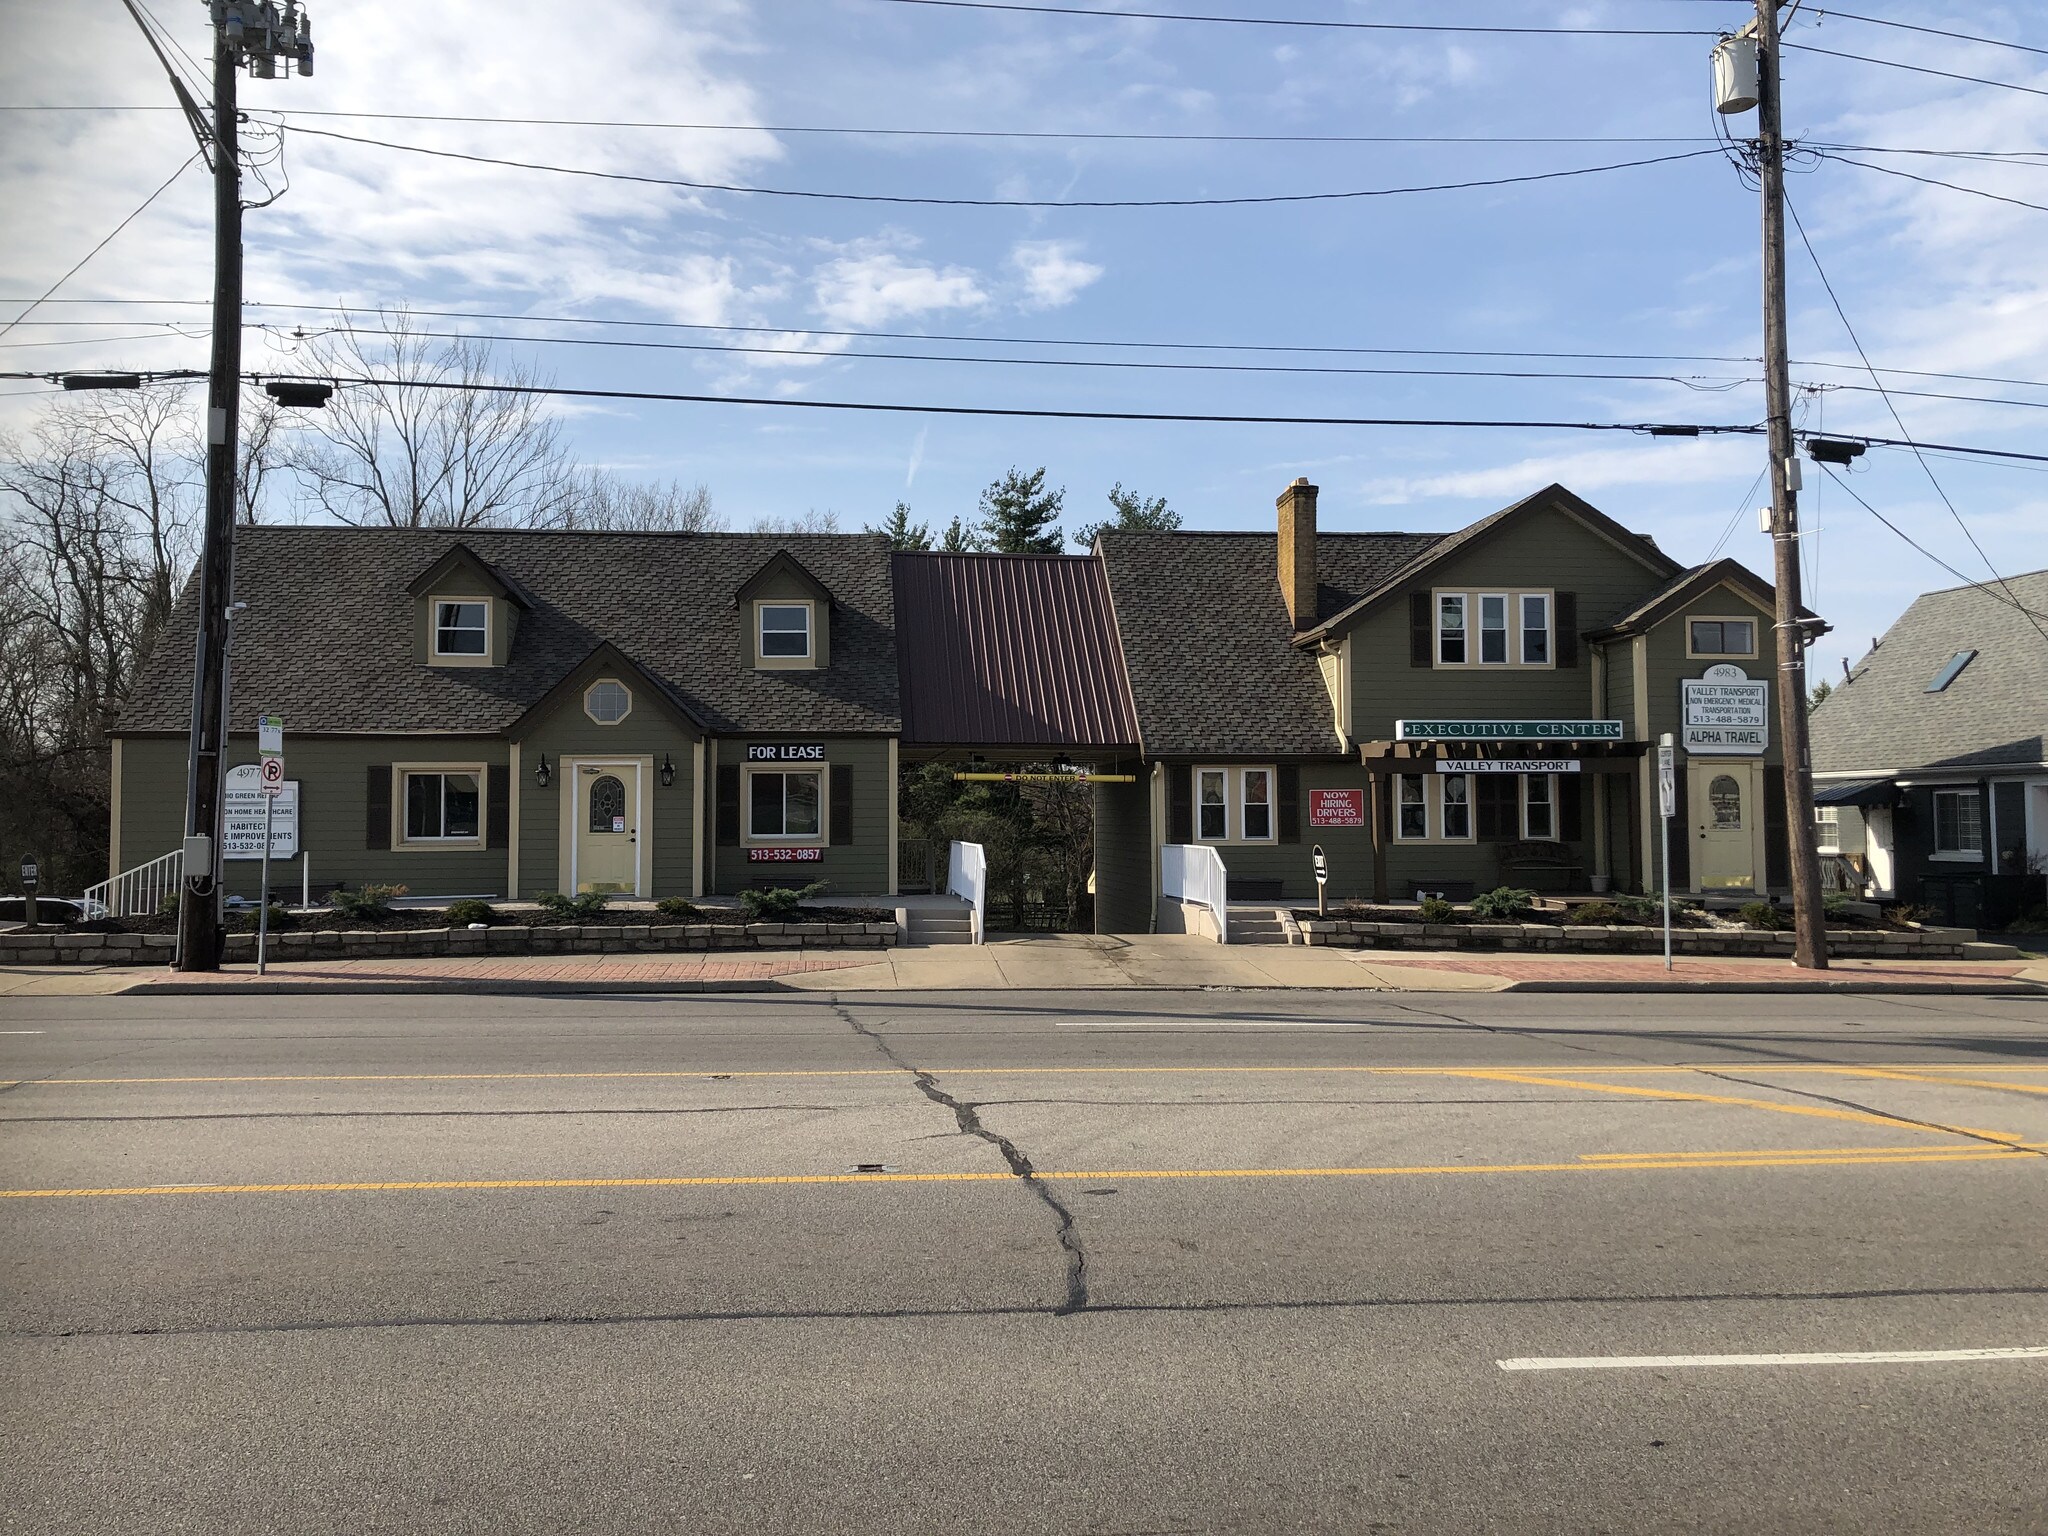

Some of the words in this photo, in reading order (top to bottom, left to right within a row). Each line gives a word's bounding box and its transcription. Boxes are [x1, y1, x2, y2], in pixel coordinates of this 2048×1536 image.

[1714, 668, 1737, 677] 4983
[1692, 687, 1718, 696] VALLEY
[1720, 688, 1760, 697] TRANSPORT
[1738, 698, 1762, 706] MEDICAL
[1701, 706, 1751, 715] TRANSPORTATION
[1693, 715, 1760, 724] 513-488-5879
[1411, 724, 1524, 735] EXECUTIVE
[1536, 724, 1615, 735] CENTER
[1689, 731, 1722, 743] ALPHA
[1724, 731, 1762, 744] TRAVEL
[749, 746, 776, 759] FOR
[780, 746, 824, 759] LEASE
[1446, 761, 1493, 771] VALLEY
[1497, 761, 1571, 771] TRANSPORT
[1320, 799, 1352, 808] HIRING
[1316, 808, 1357, 817] DRIVERS
[1312, 817, 1362, 825] 513-488-5879
[230, 832, 293, 840] IMPROVEENTS
[223, 842, 276, 850] 513-532-087
[751, 849, 820, 860] 513-532-0857
